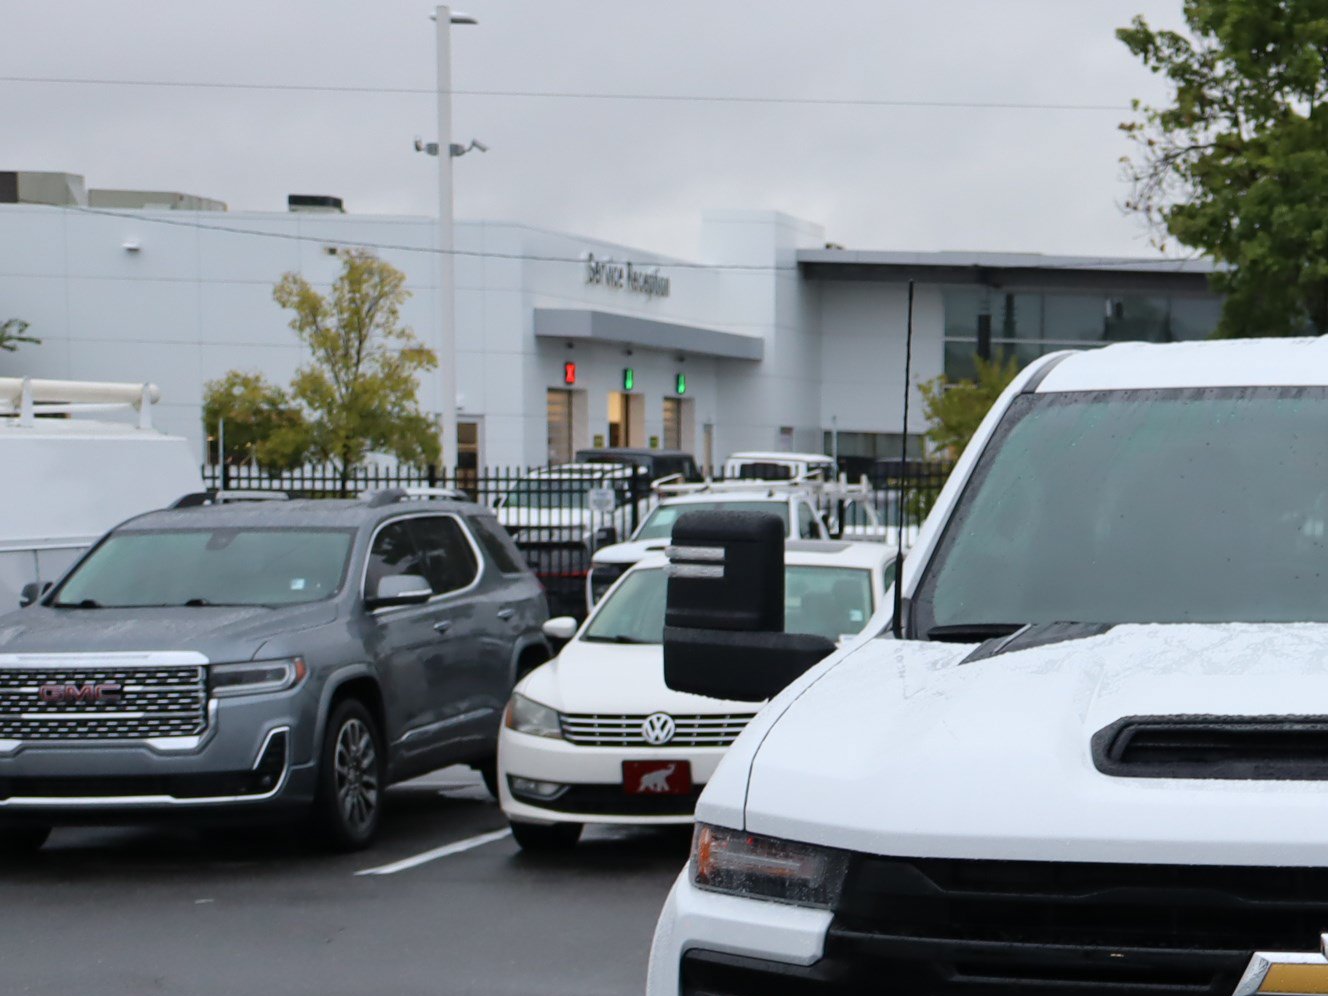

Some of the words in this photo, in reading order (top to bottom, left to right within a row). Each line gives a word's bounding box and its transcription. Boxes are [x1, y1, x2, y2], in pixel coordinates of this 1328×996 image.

[585, 251, 624, 289] Service
[626, 261, 670, 300] Reception
[39, 683, 122, 702] GMC
